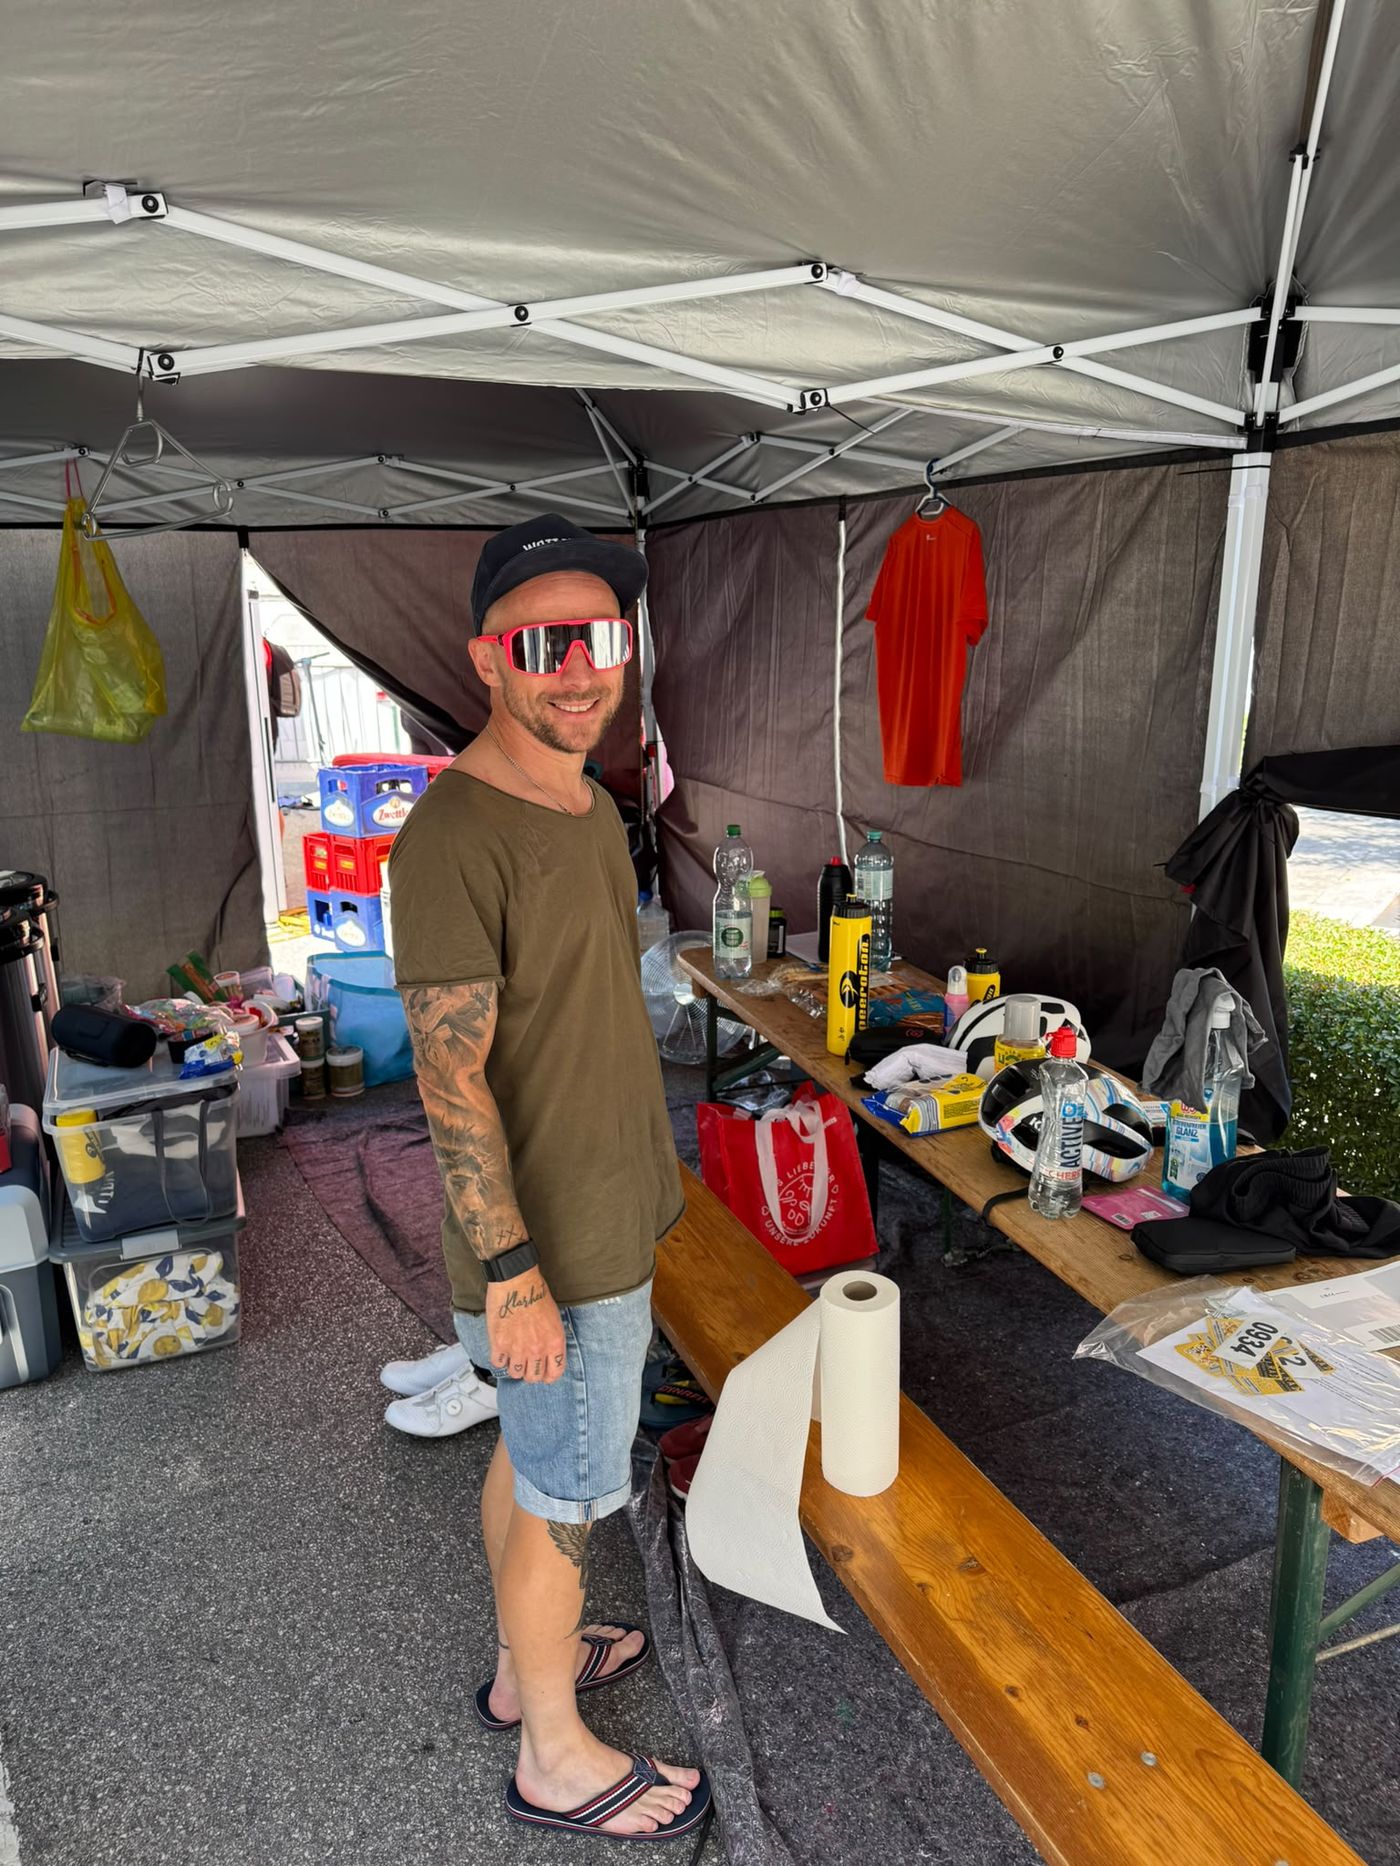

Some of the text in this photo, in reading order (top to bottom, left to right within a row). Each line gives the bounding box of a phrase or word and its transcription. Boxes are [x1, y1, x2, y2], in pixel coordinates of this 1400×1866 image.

[1060, 1117, 1083, 1168] ACTIVE
[1175, 1126, 1199, 1138] GLANZ
[1230, 1321, 1279, 1358] 0934
